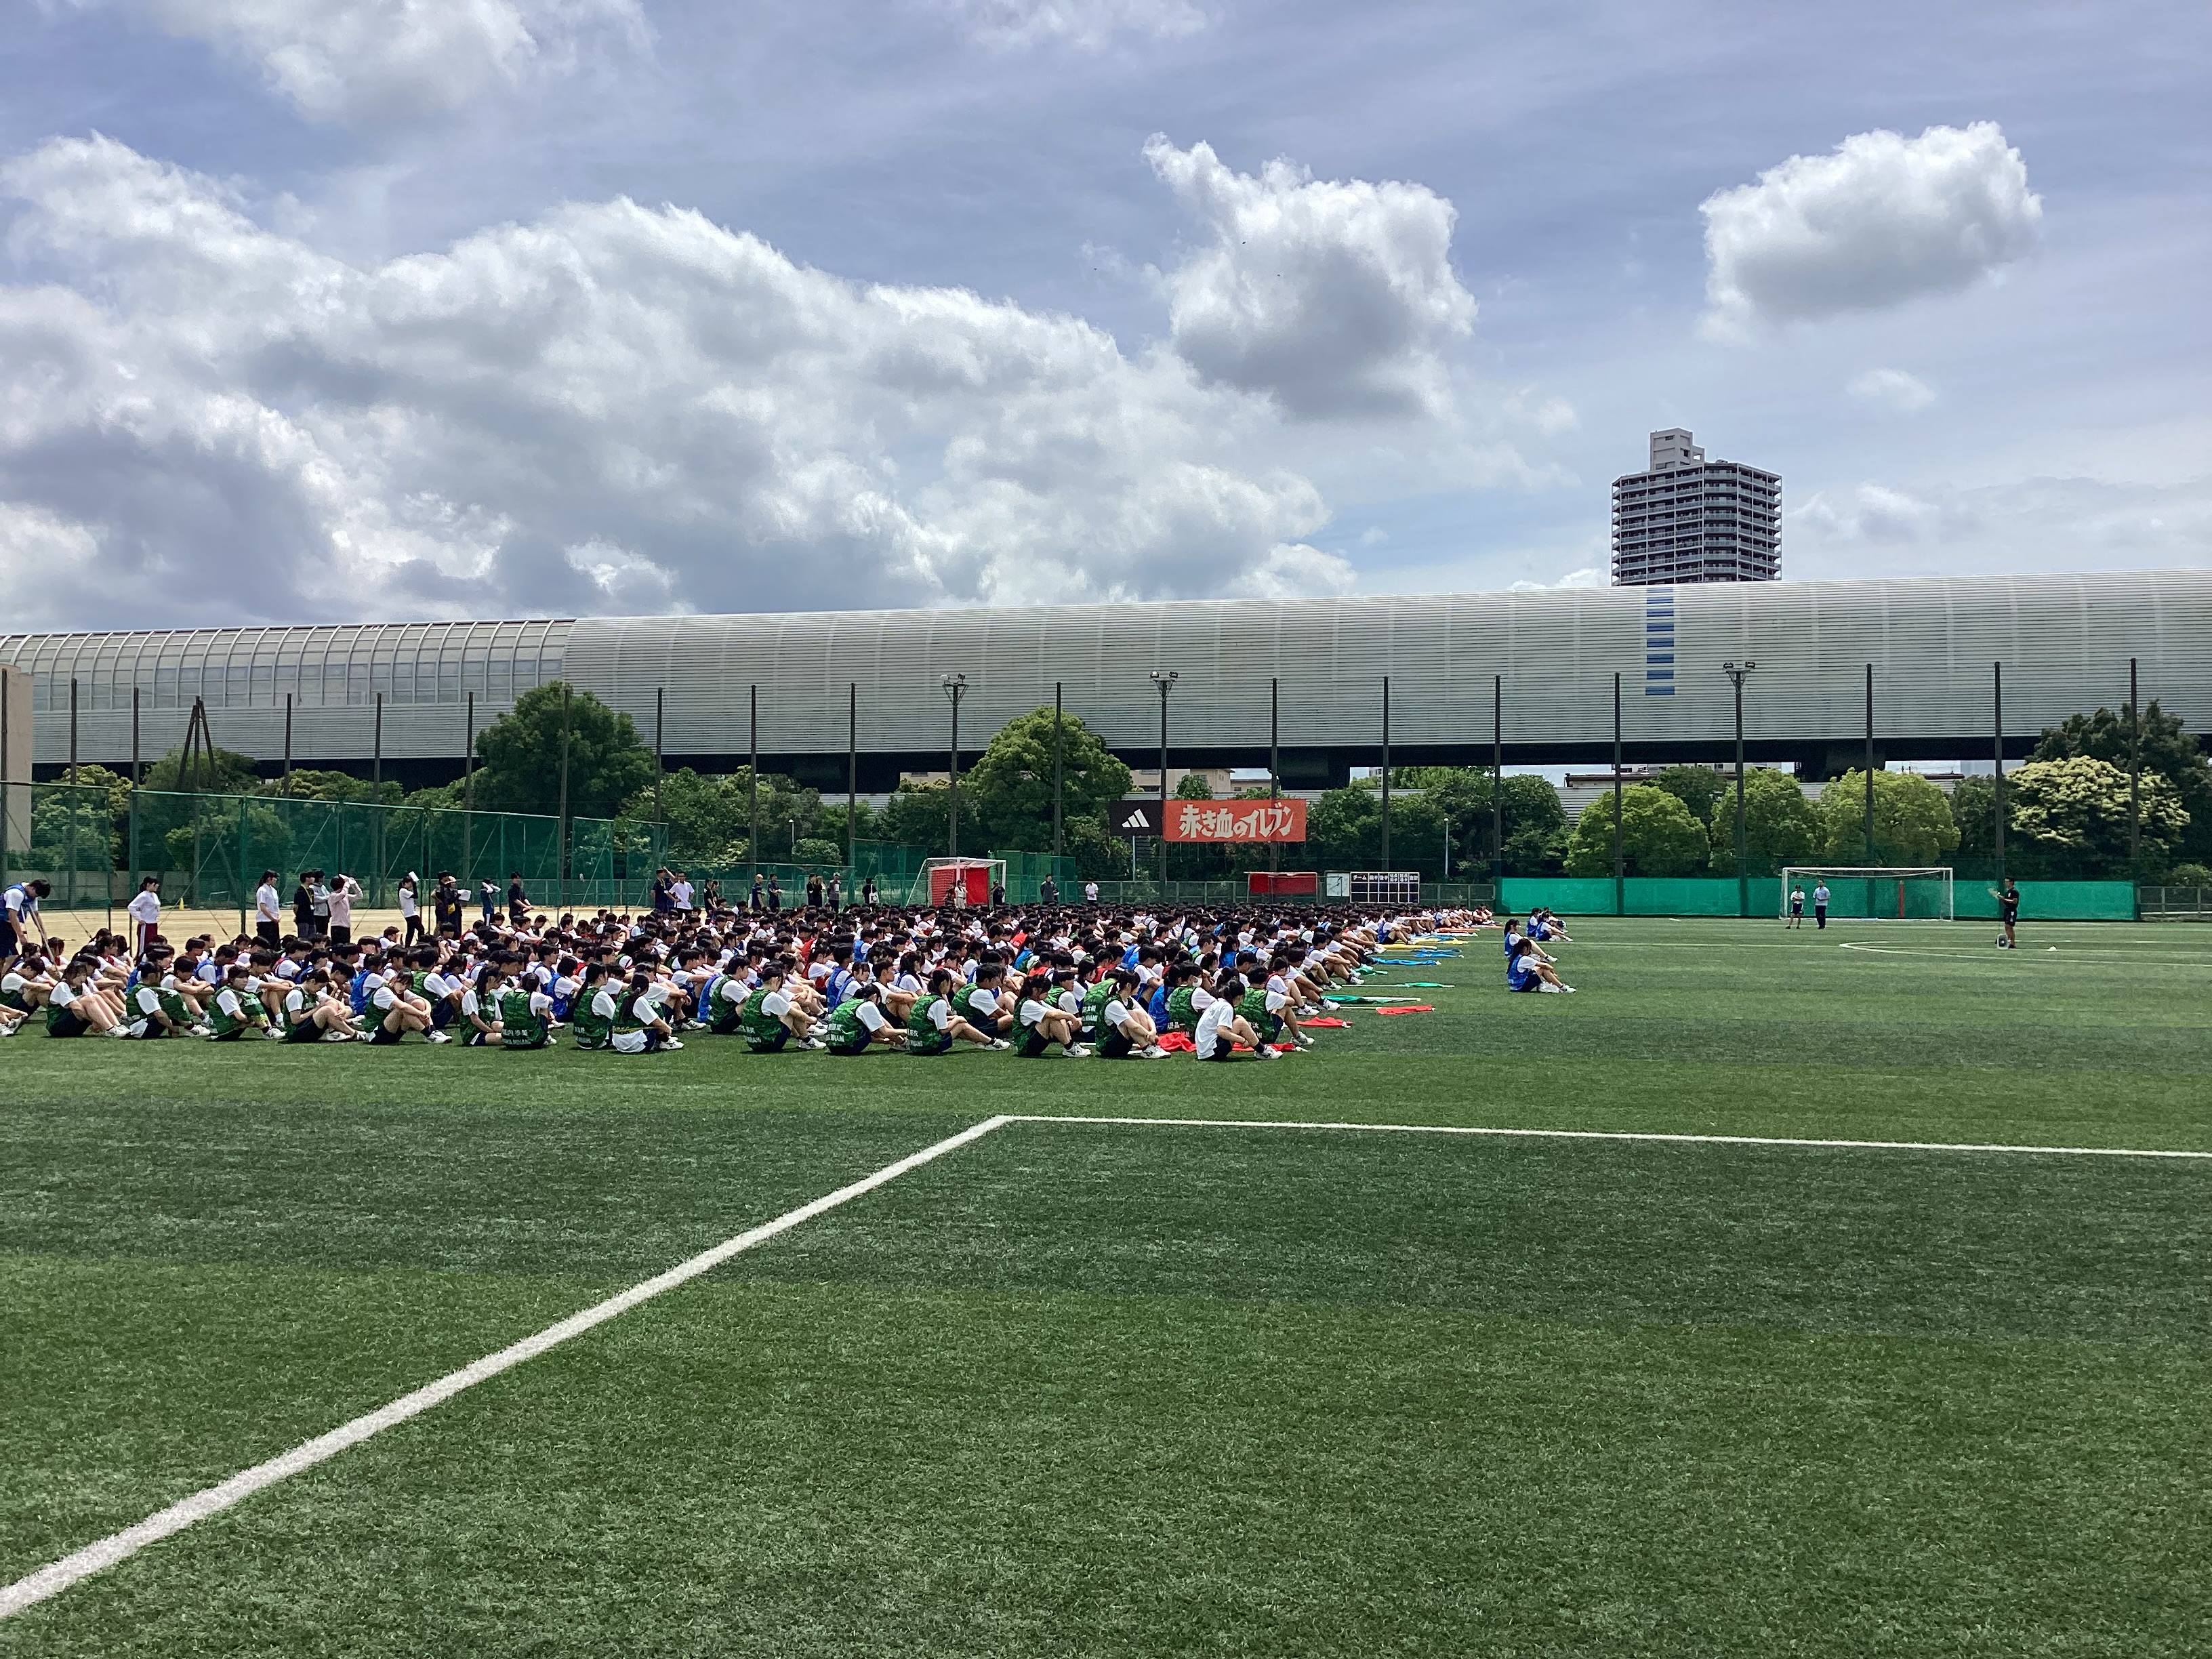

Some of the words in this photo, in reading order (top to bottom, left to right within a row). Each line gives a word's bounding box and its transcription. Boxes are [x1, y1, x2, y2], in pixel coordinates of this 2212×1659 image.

[1179, 802, 1294, 839] 赤き血のイレブン
